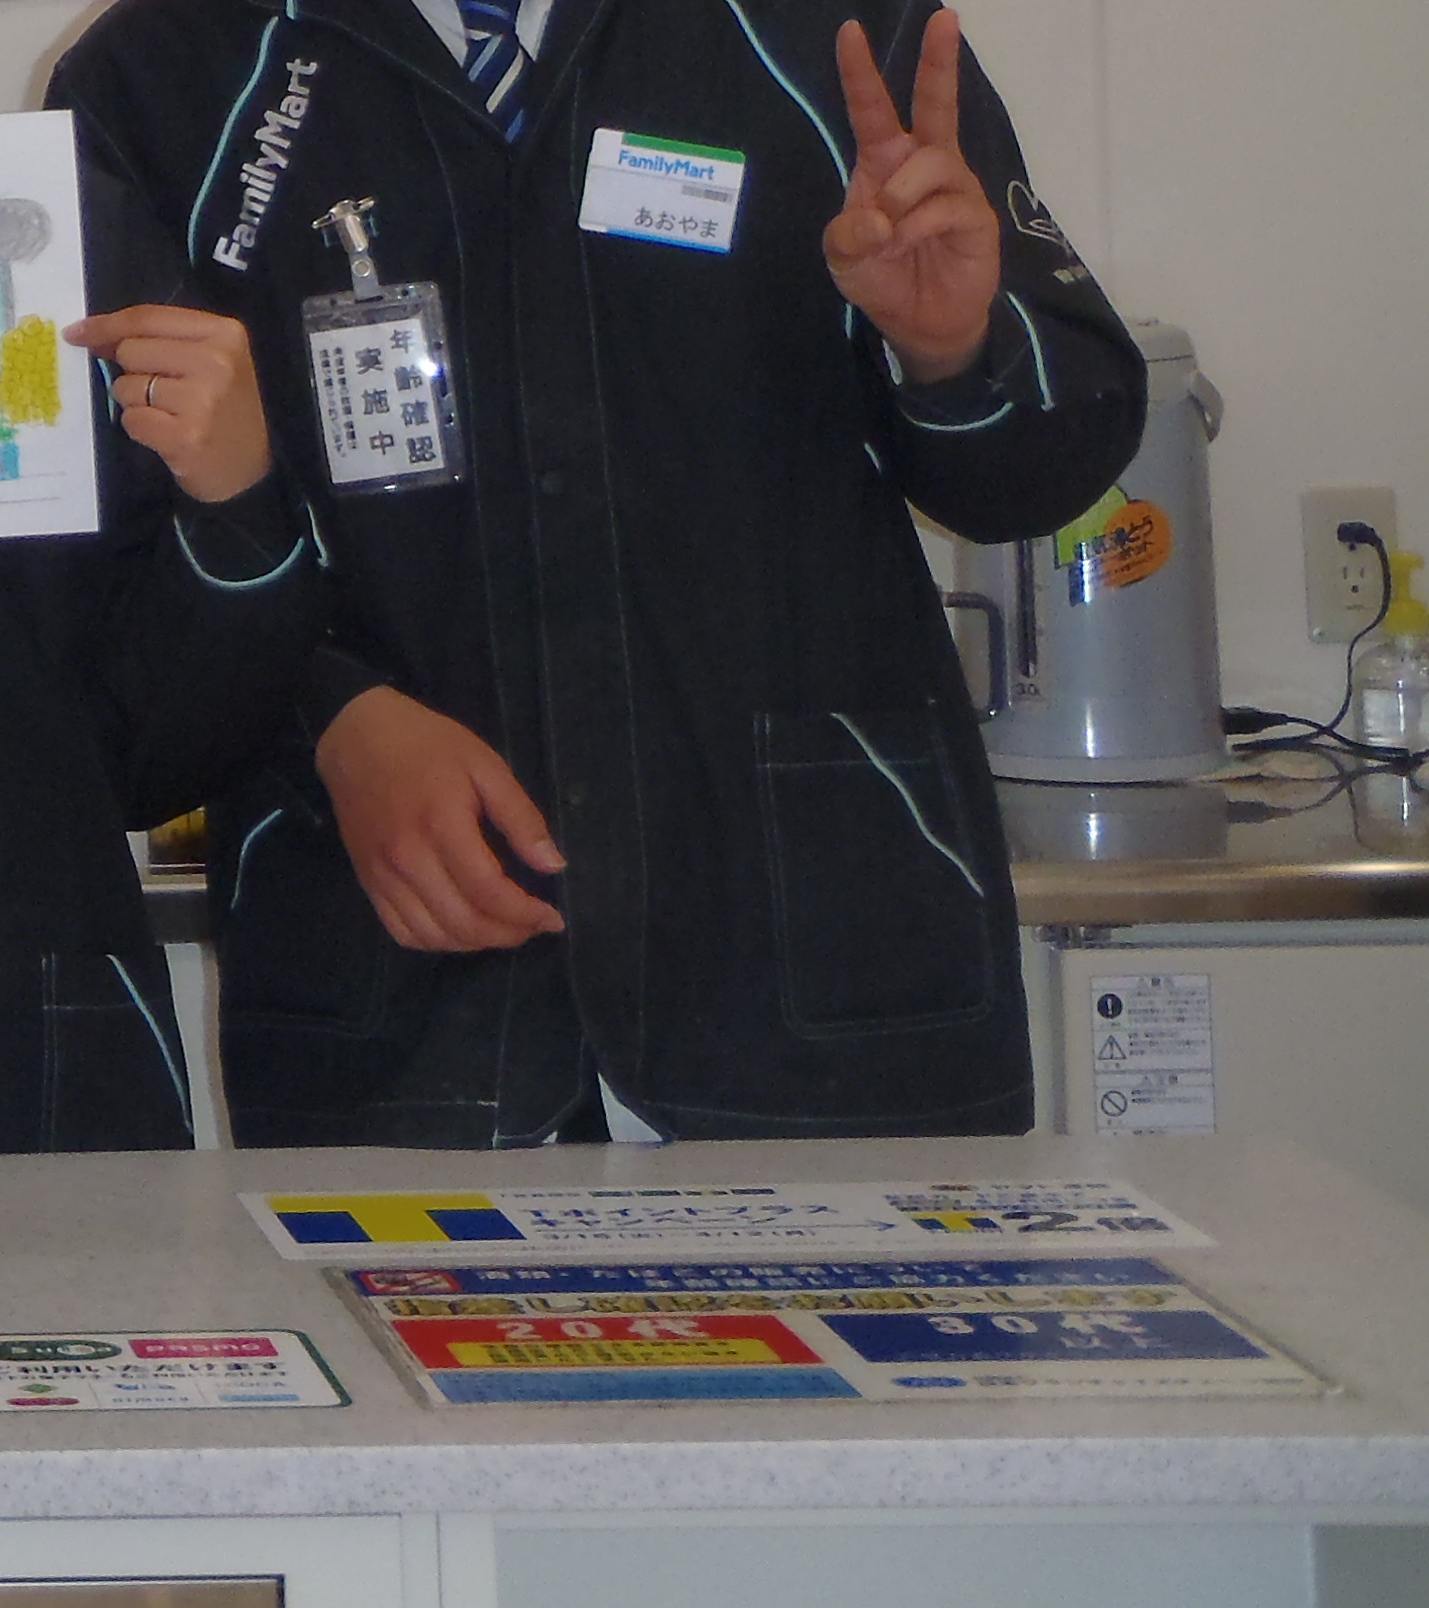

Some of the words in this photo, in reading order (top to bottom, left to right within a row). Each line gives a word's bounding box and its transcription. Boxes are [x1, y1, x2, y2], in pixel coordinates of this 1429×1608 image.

[213, 57, 318, 271] FamilyMart
[618, 150, 715, 180] FamilyMart
[634, 207, 719, 238] あおやま
[354, 347, 395, 457] 実施中
[389, 329, 437, 463] 年齢確認
